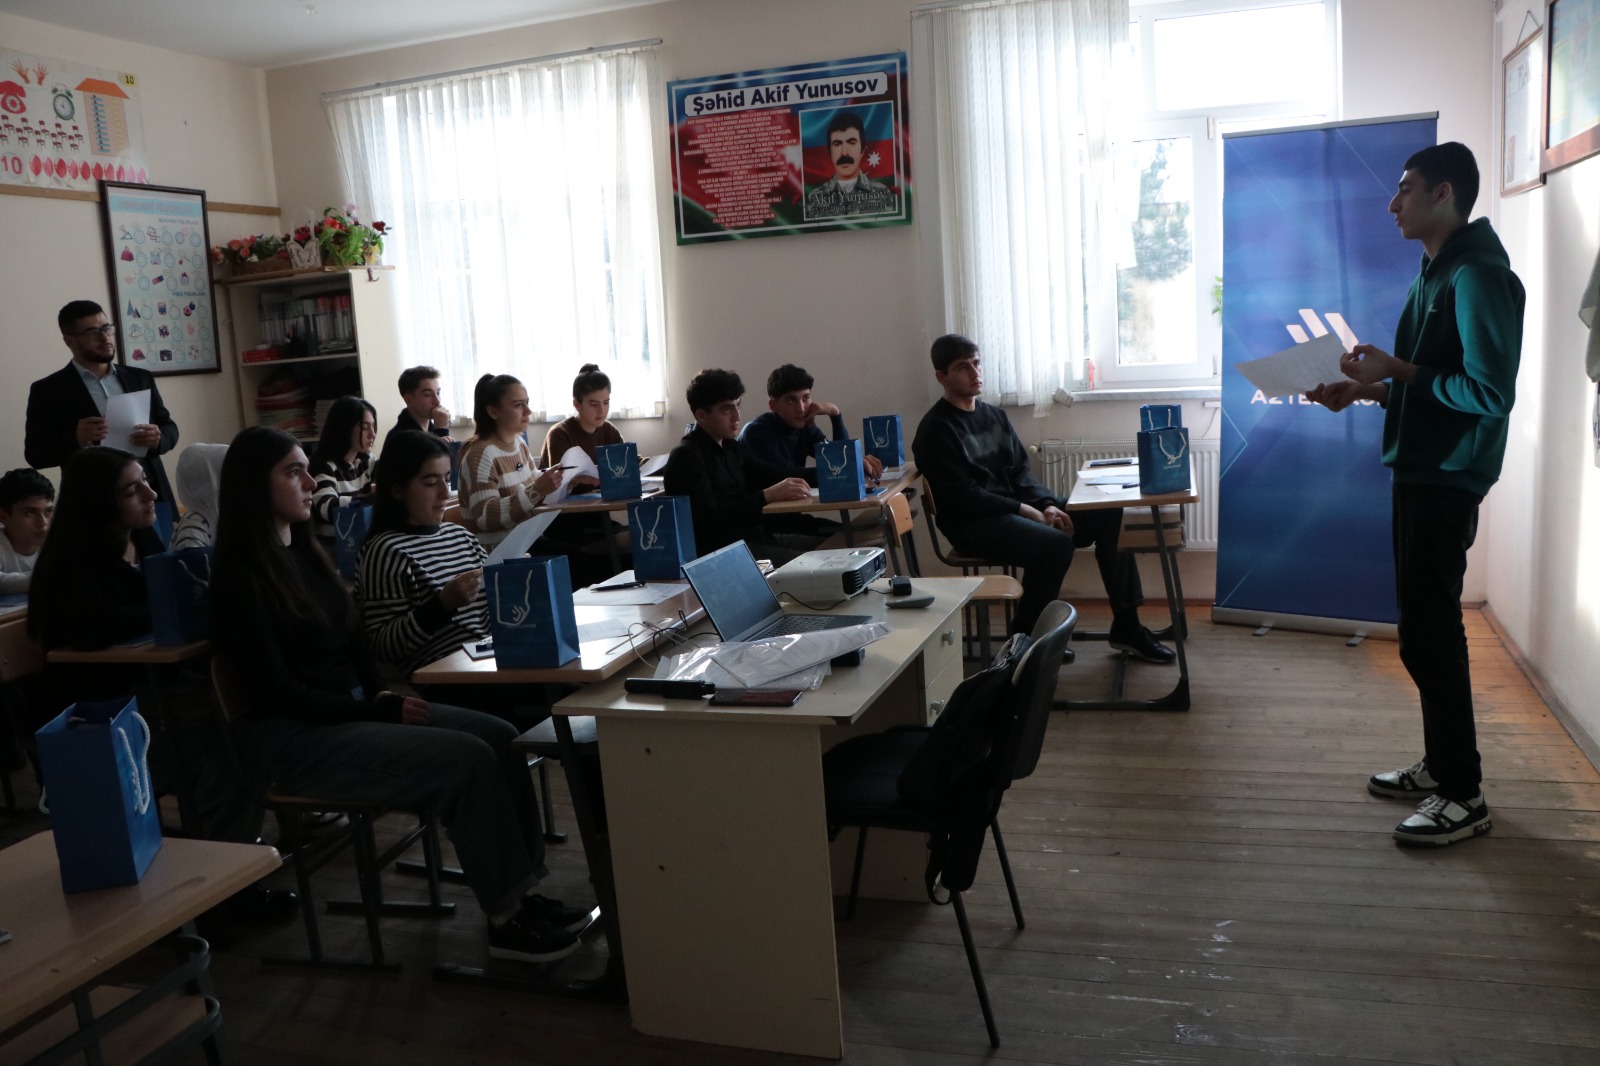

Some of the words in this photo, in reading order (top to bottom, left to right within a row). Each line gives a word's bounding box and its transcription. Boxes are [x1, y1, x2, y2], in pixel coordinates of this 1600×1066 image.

[125, 75, 135, 84] 10
[693, 90, 745, 114] Şəhid
[751, 84, 790, 106] Akif
[795, 78, 878, 100] Yunusov
[1, 155, 22, 174] 10
[814, 192, 836, 204] Akif
[841, 191, 886, 203] Yunusov
